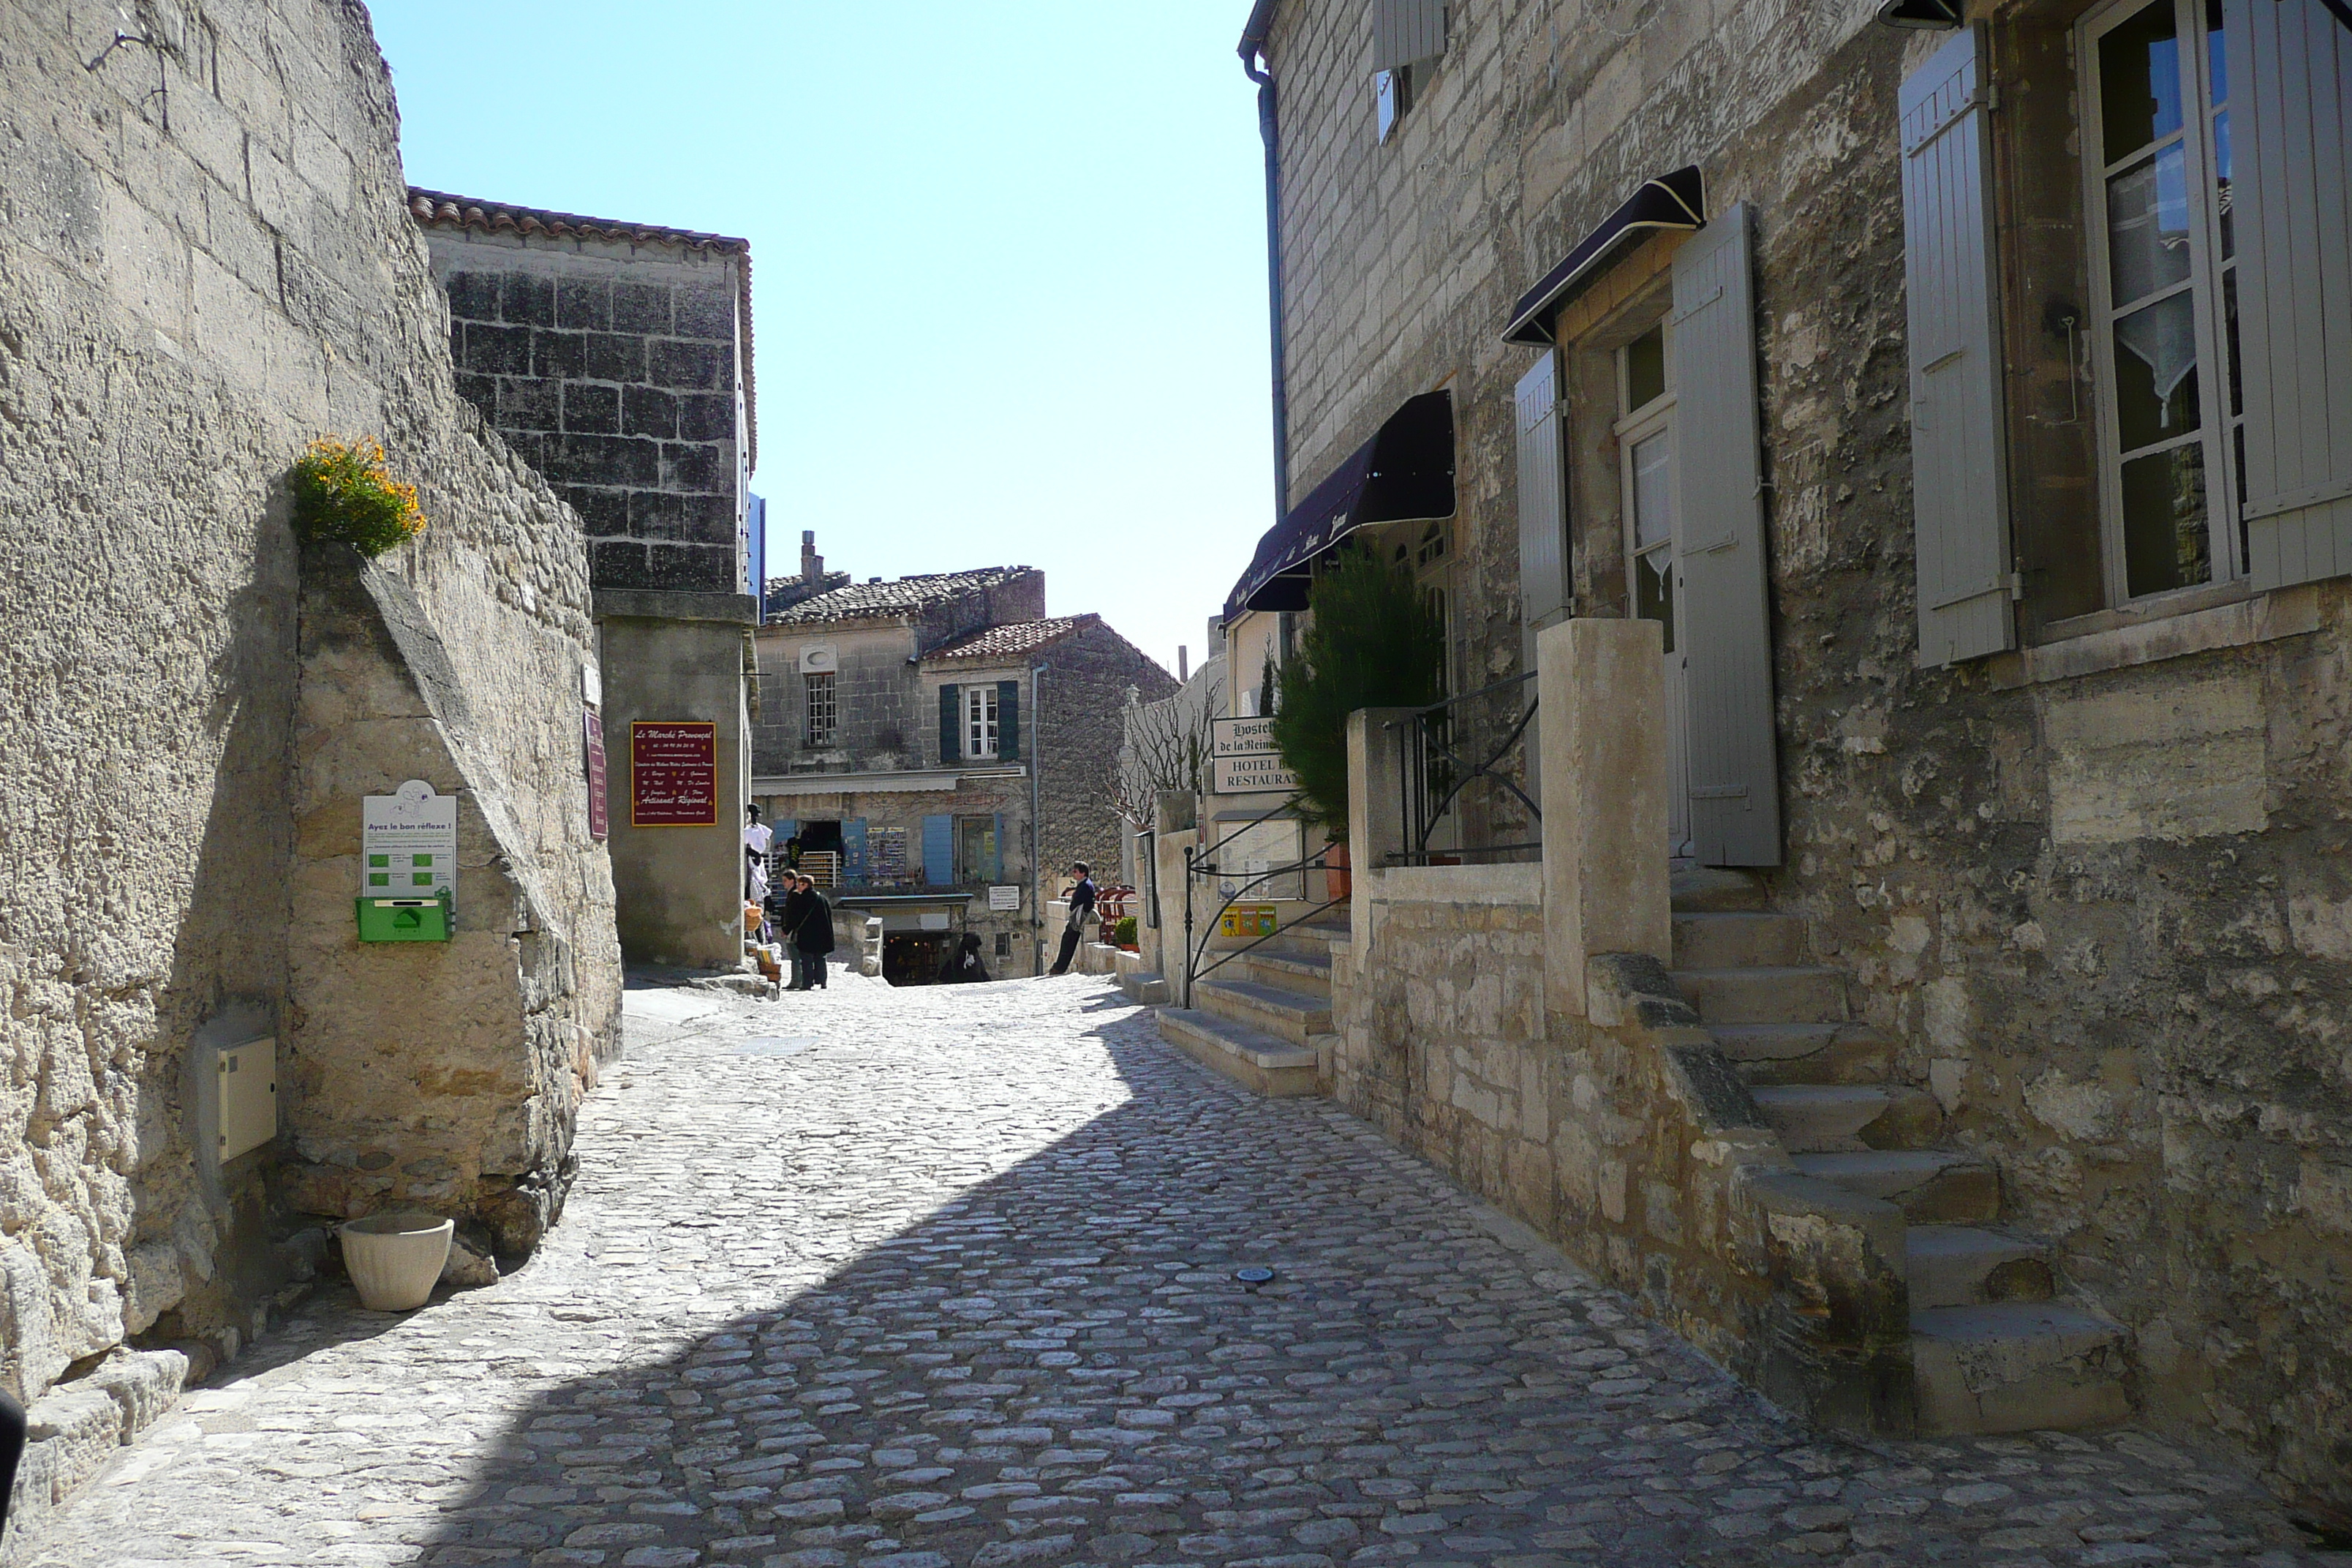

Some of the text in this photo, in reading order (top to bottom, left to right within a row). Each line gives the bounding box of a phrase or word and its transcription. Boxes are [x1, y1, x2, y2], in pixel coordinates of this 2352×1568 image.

[635, 730, 712, 741] Le Marché Provençal
[1220, 742, 1231, 751] de
[1234, 740, 1243, 751] la
[1233, 760, 1275, 772] HOTEL
[1227, 774, 1303, 787] RESTAURAN
[641, 795, 708, 806] Artisanat Régional
[368, 823, 388, 832] Ayez
[418, 822, 446, 830] réflexe
